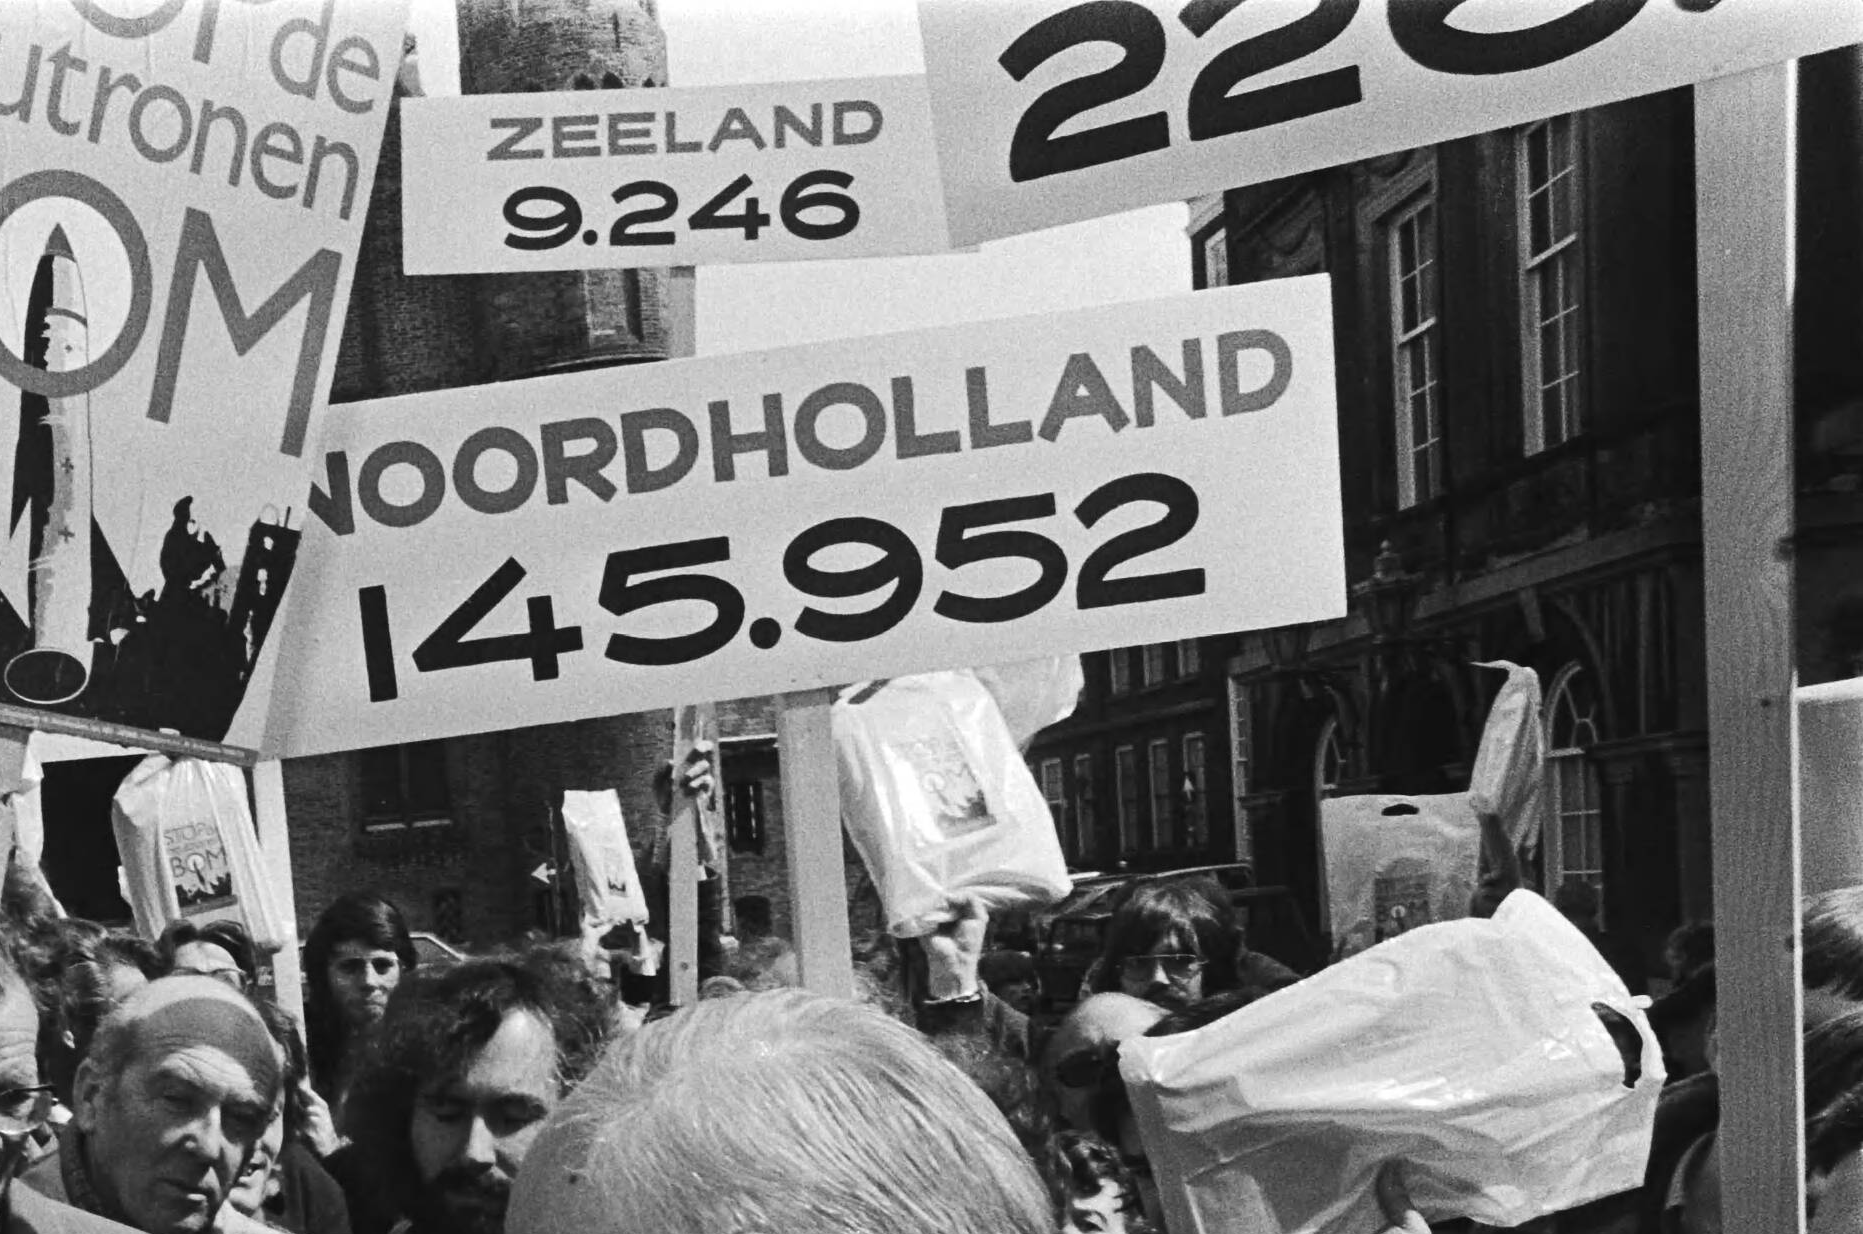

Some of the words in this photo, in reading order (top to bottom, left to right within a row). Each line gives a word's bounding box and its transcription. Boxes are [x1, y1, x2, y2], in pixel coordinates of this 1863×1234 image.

[269, 0, 381, 115] de
[486, 99, 884, 161] ZEELAND
[502, 169, 860, 251] 9.246
[307, 328, 1293, 536] NOORDHOLLAND
[358, 471, 1207, 703] 145.952
